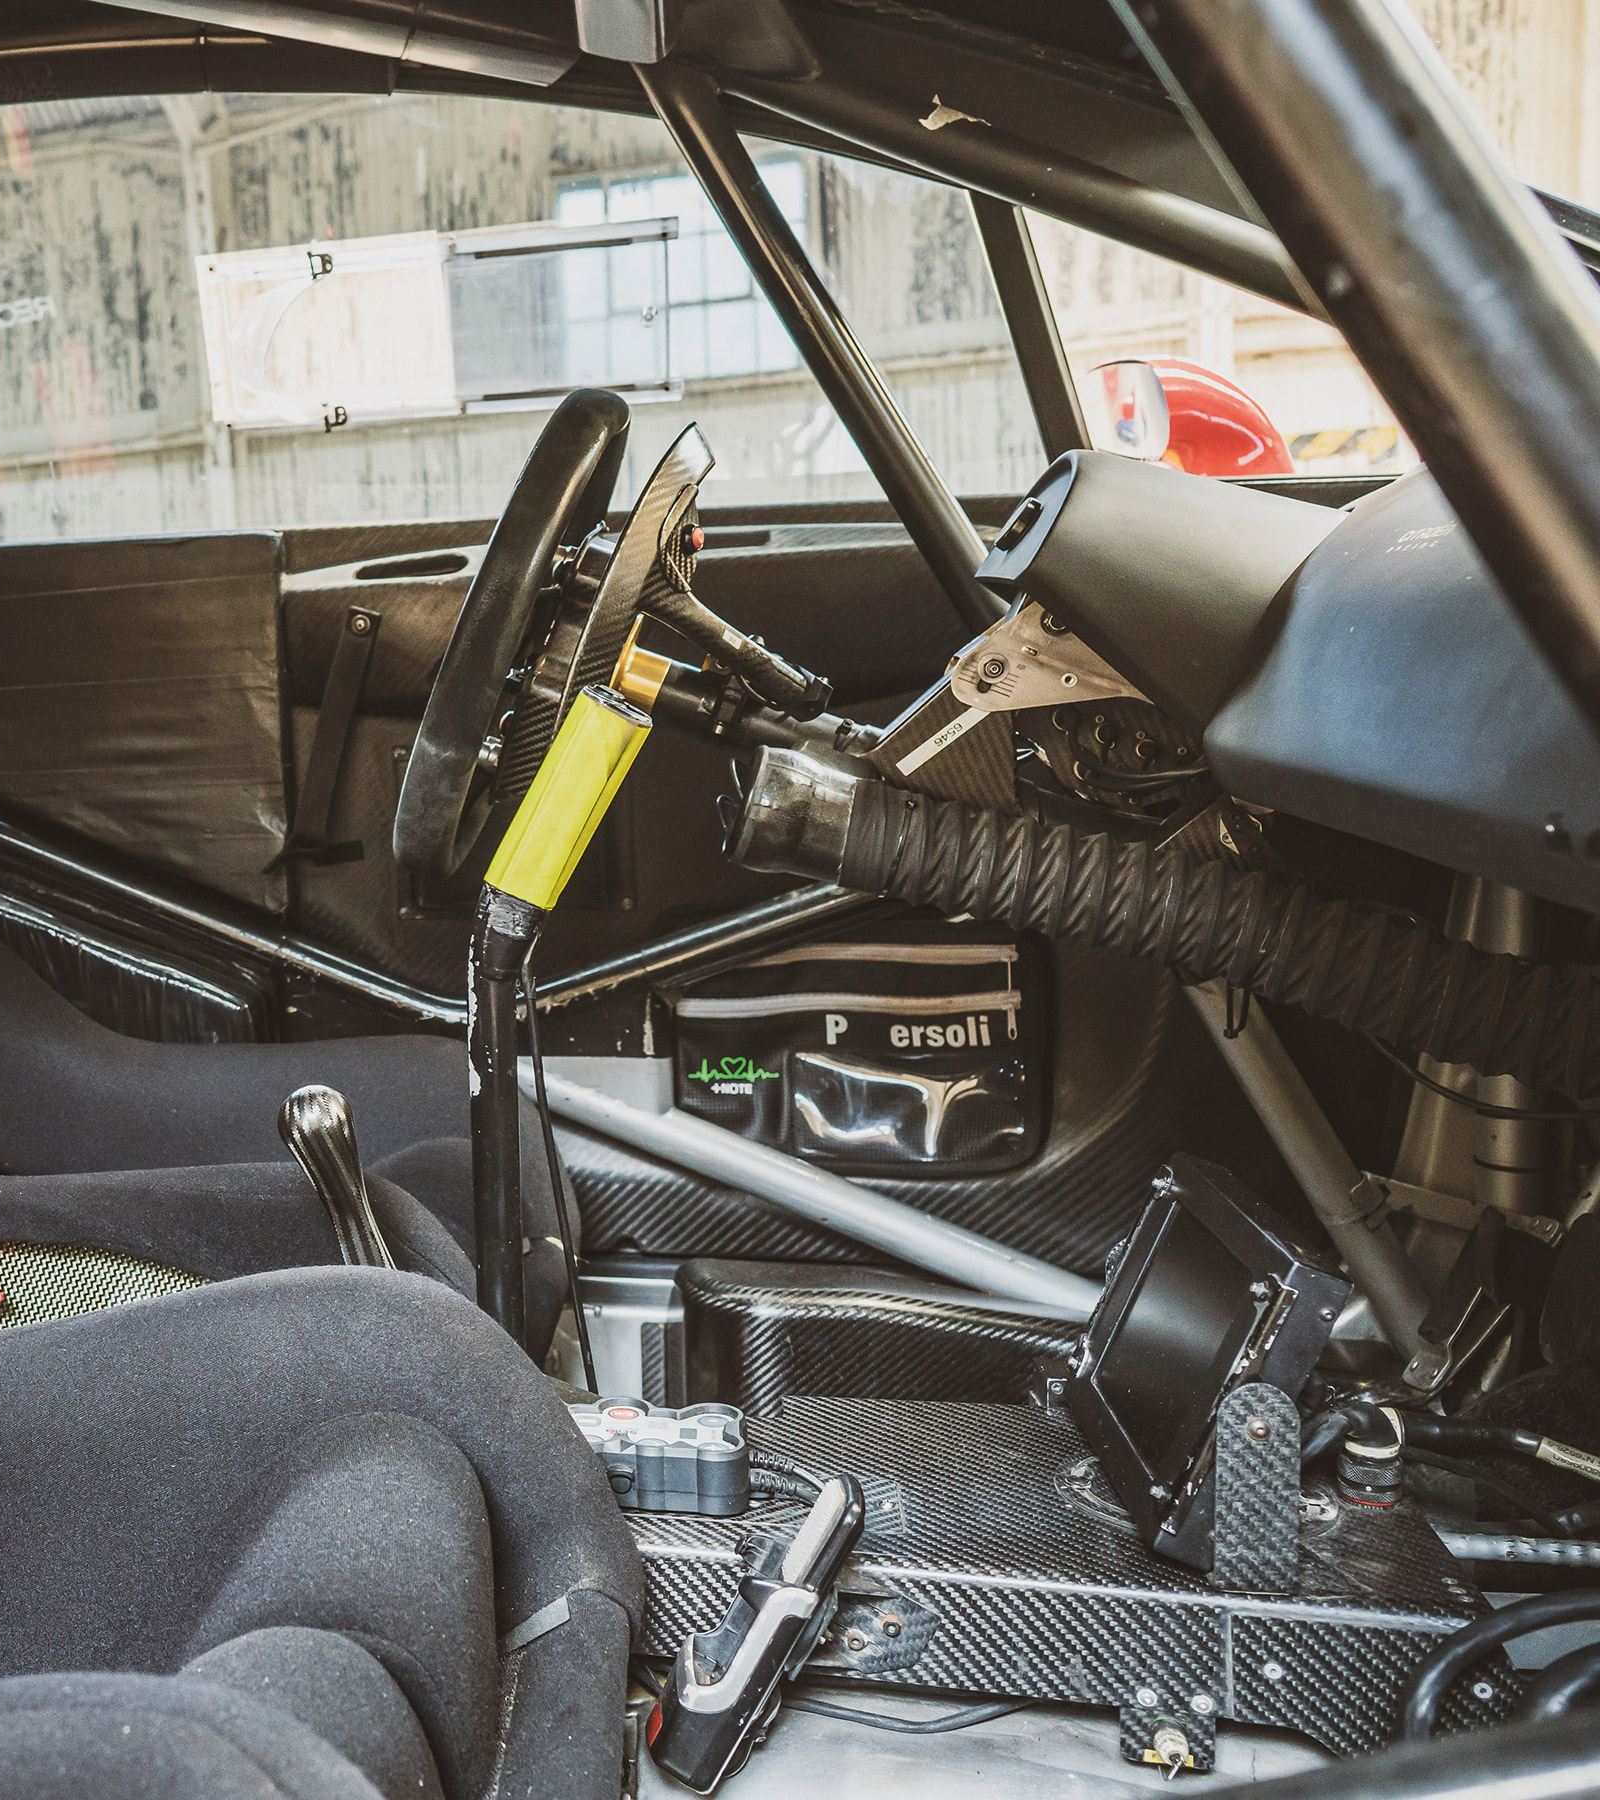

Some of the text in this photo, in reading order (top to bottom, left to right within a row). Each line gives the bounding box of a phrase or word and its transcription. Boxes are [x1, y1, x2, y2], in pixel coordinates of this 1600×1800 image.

[933, 722, 963, 747] 6546
[825, 1014, 991, 1047] P ersoli
